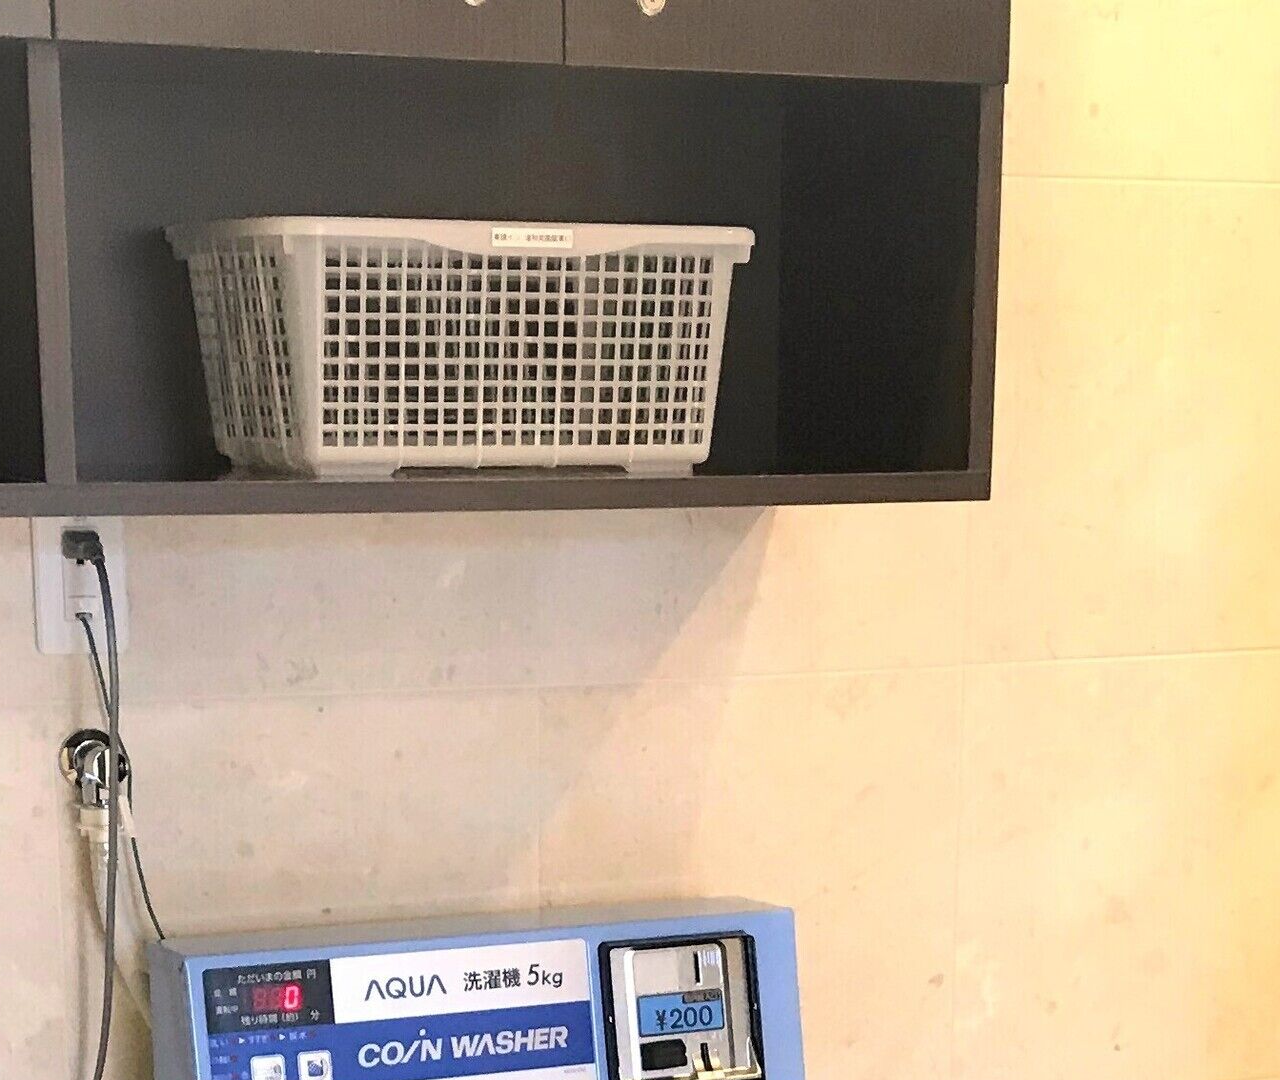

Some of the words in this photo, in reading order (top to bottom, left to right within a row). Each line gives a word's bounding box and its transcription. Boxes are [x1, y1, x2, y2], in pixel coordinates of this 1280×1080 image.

[365, 974, 447, 1001] AQUA
[463, 968, 521, 992] 洗濯機
[527, 964, 563, 988] 5kg
[283, 986, 300, 1009] 0
[655, 1005, 713, 1031] ¥200
[451, 1026, 568, 1059] WASHER
